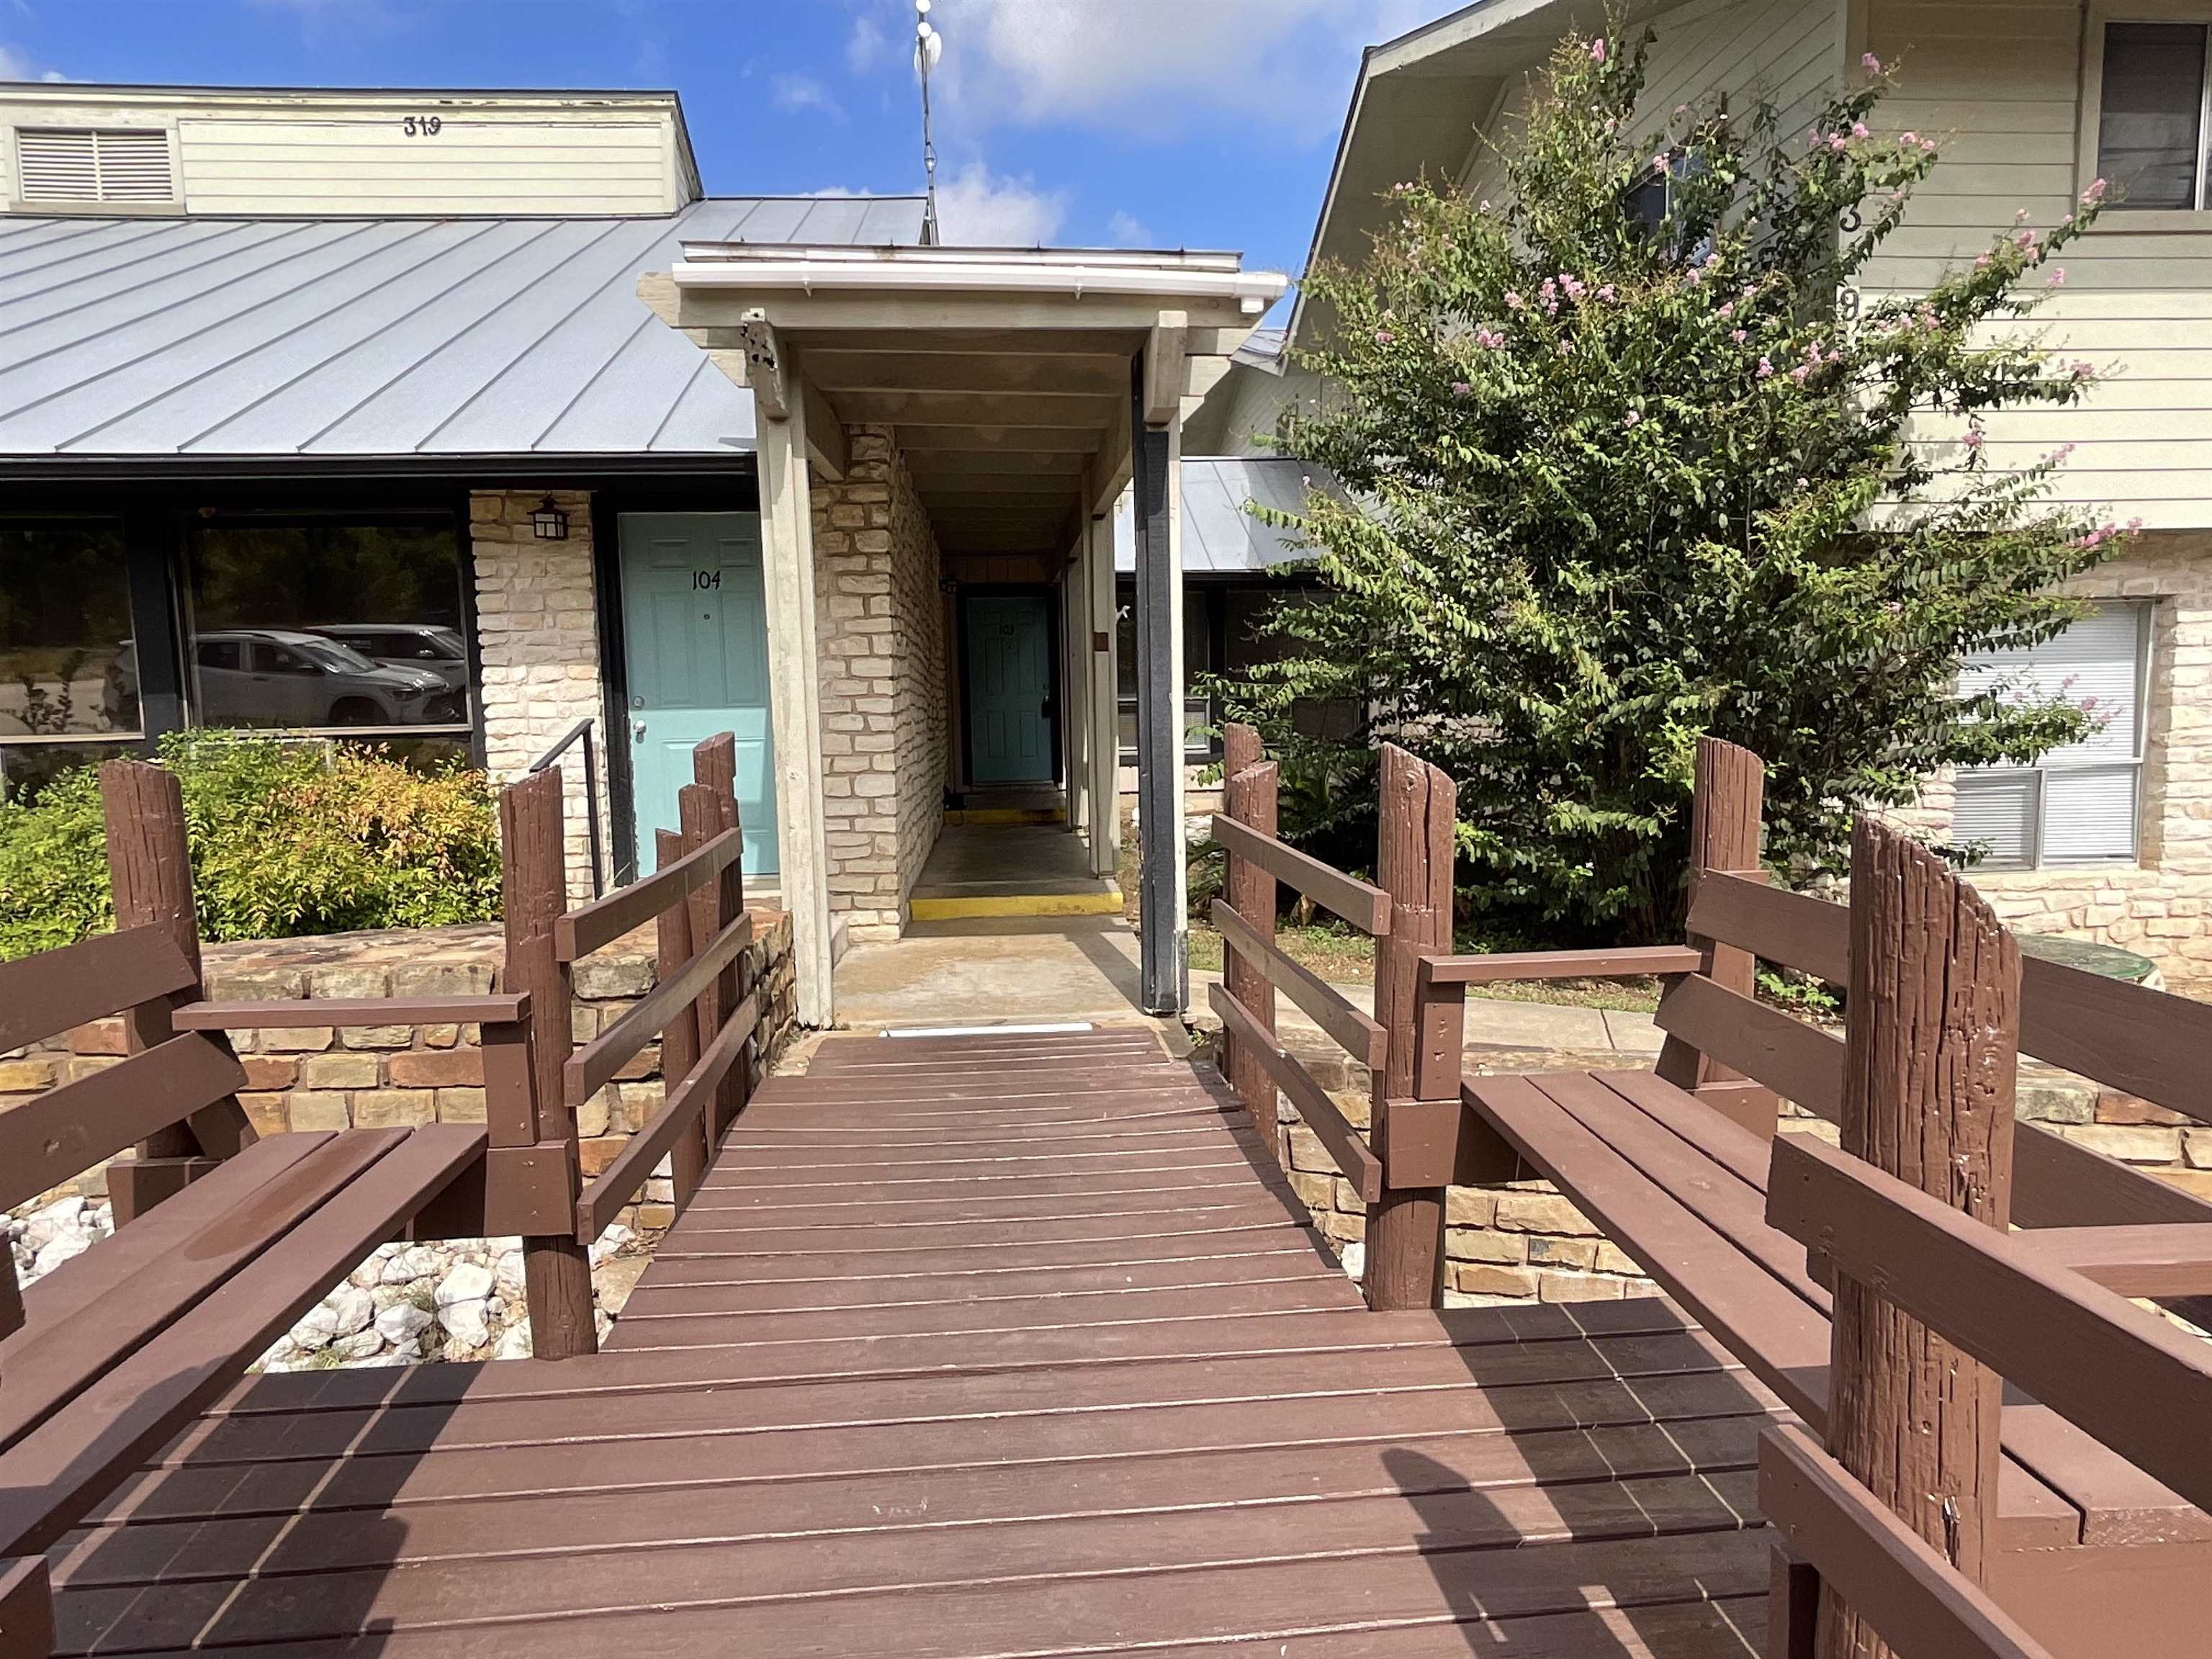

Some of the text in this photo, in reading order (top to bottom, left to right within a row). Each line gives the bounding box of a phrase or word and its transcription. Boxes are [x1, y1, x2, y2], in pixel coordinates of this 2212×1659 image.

[404, 116, 441, 137] 319
[1839, 203, 1861, 321] 39
[693, 570, 721, 590] 104
[998, 624, 1014, 635] 103
